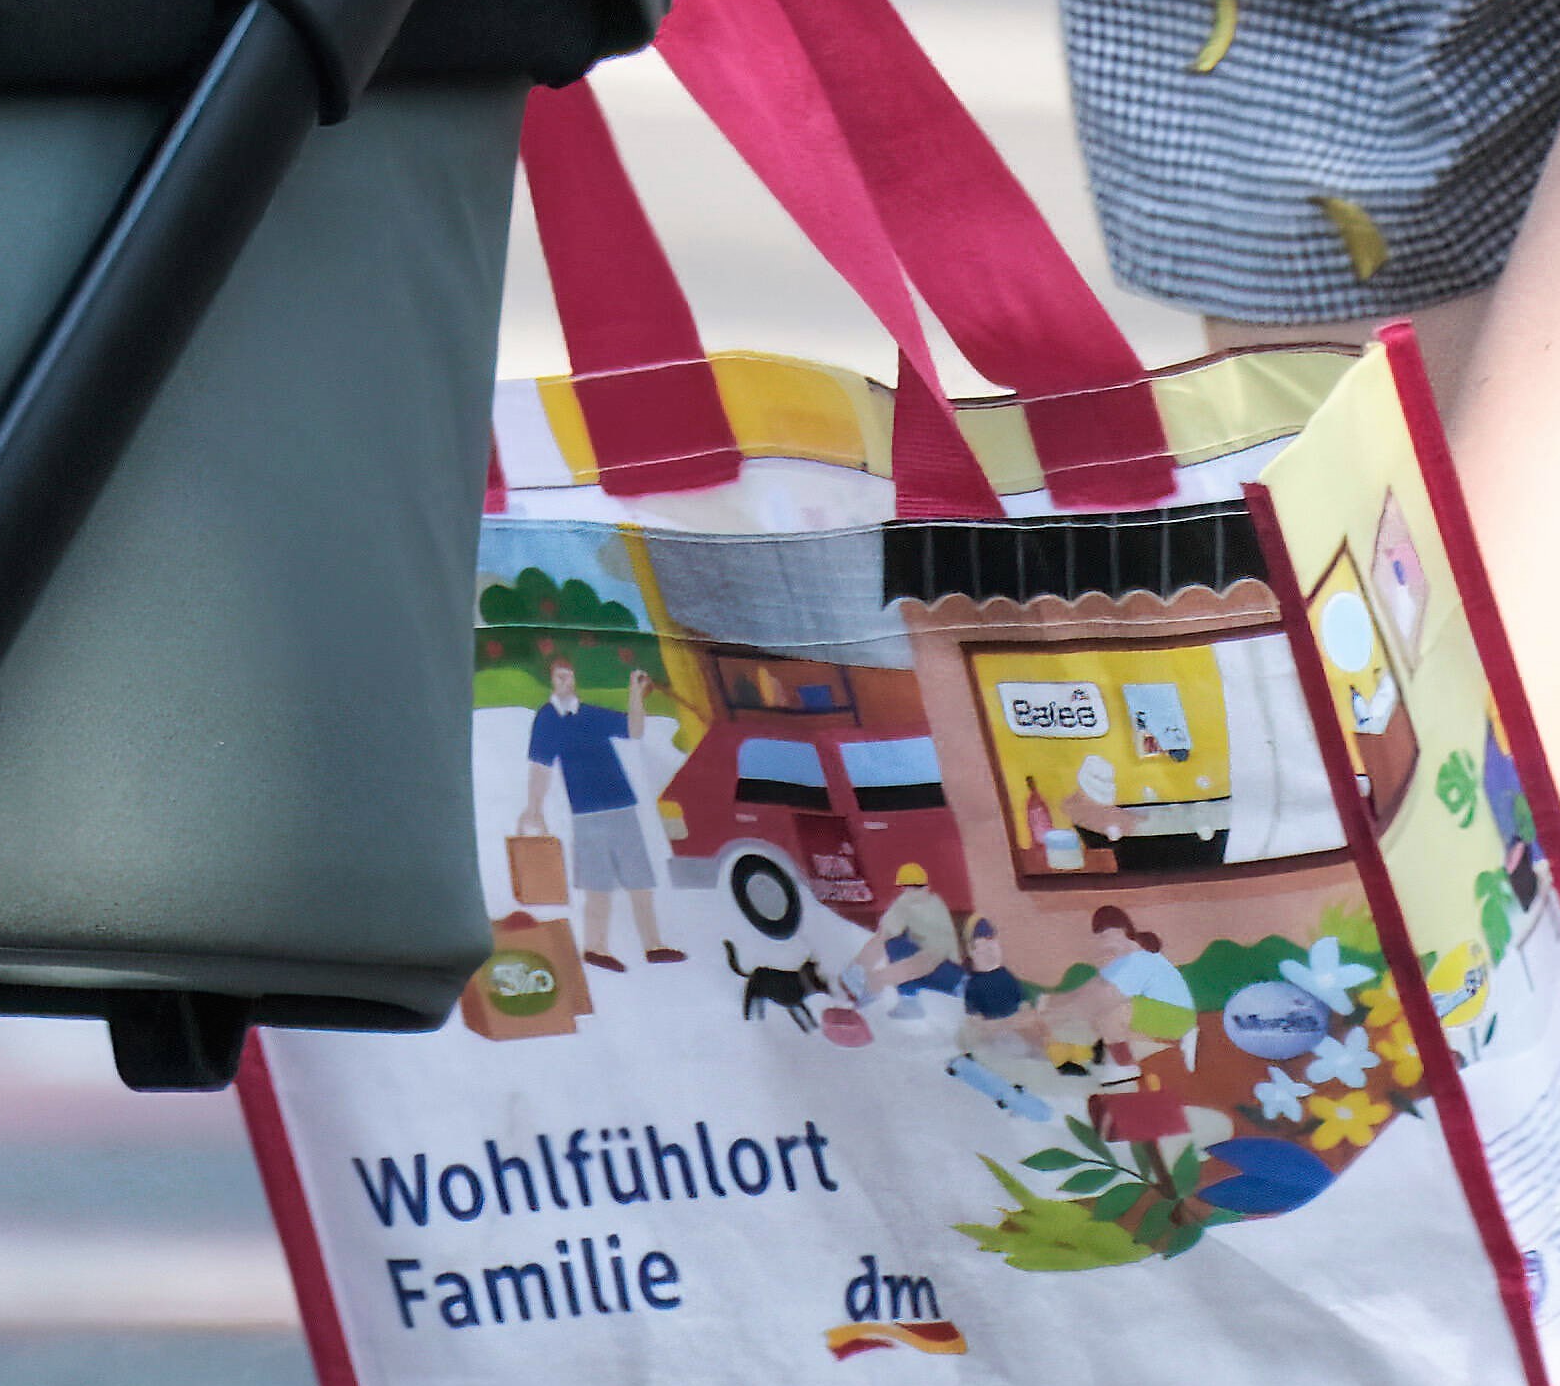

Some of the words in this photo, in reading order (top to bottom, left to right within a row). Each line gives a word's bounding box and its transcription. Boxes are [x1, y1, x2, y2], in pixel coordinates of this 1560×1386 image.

[352, 1121, 838, 1227] Wohlfühlort
[386, 1234, 681, 1328] Familie
[845, 1255, 941, 1322] dm
